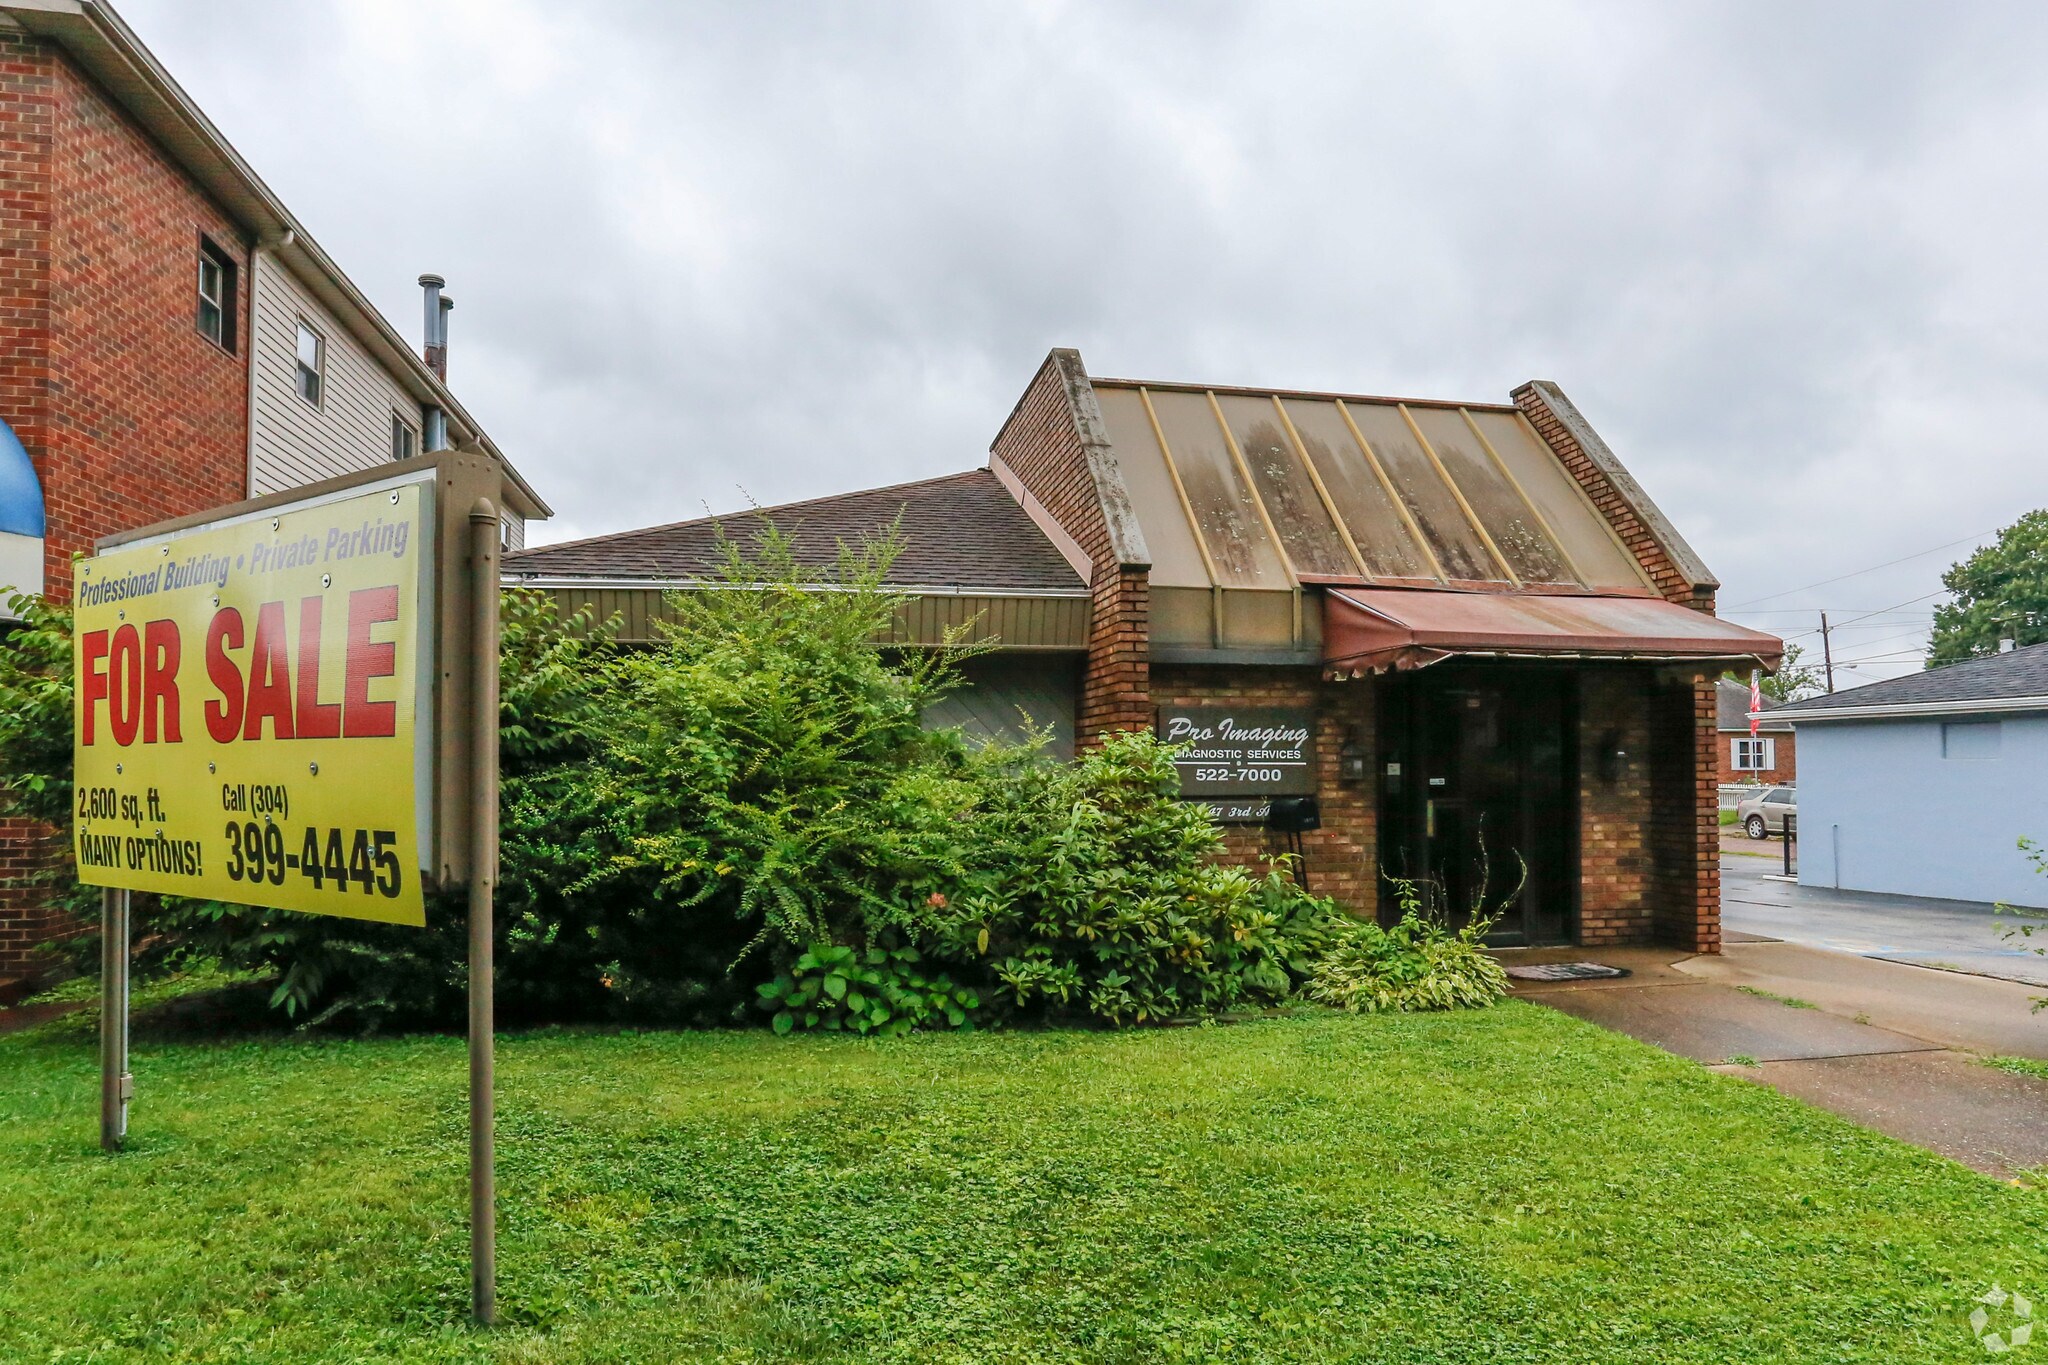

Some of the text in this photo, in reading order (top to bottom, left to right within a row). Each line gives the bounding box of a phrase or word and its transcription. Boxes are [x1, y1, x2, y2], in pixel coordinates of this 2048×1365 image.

[79, 518, 410, 609] Professional Building Private Parking
[82, 585, 399, 747] FOR SALE
[1168, 717, 1309, 749] Pro Imaging
[1174, 749, 1301, 759] DIAGNOSTIC SERVICES
[1195, 768, 1282, 781] 522-7000
[78, 787, 166, 828] 2,600 sq. ft.
[222, 783, 289, 820] Call (304)
[1228, 806, 1252, 817] 3rd
[80, 834, 203, 877] MANY OPTIONS!
[225, 821, 401, 898] 399-4445
